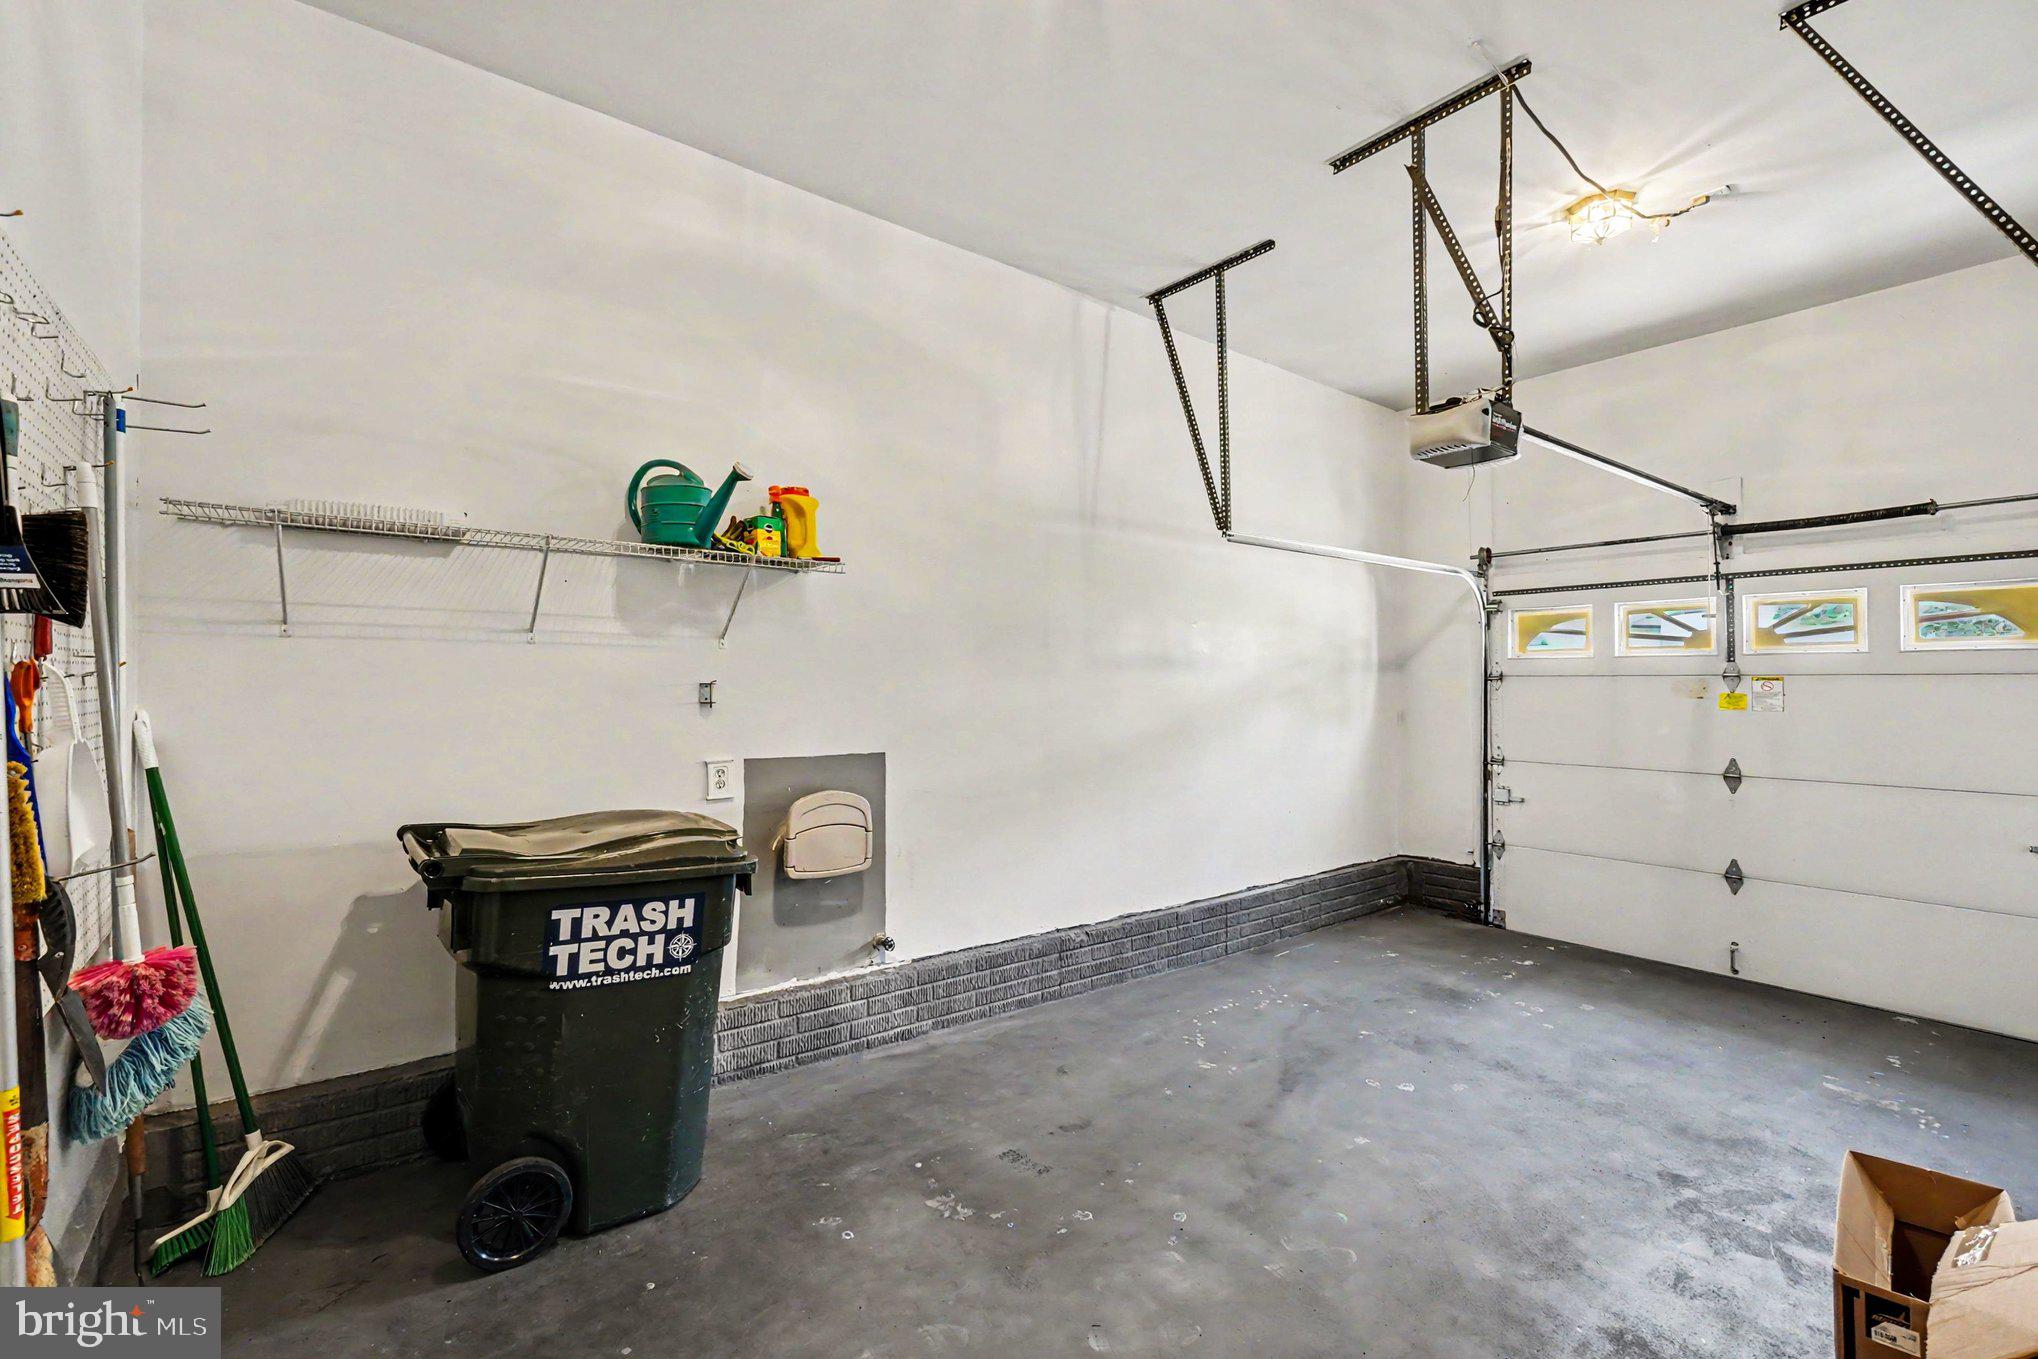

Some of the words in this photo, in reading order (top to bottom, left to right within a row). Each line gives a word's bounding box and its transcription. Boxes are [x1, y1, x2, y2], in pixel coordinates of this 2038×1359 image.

[551, 898, 695, 941] TRASH
[549, 933, 666, 977] TECH
[549, 964, 692, 990] www.trashtech.com
